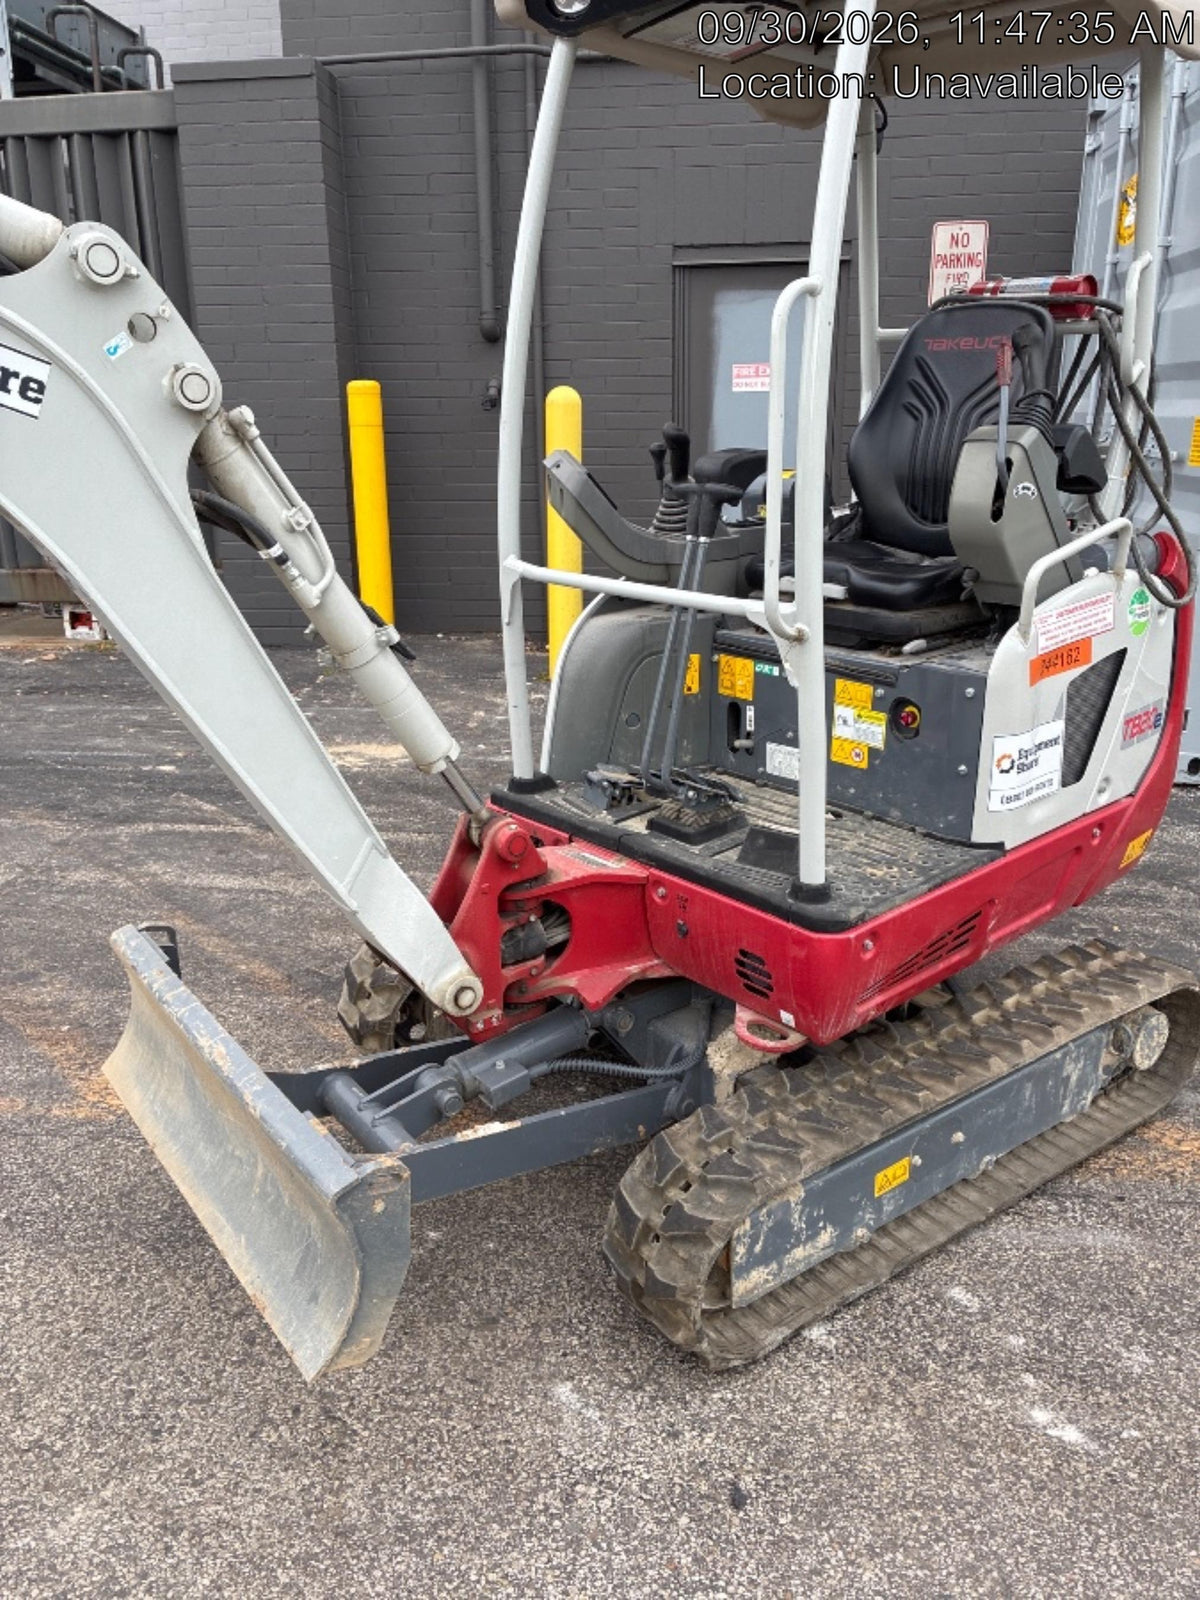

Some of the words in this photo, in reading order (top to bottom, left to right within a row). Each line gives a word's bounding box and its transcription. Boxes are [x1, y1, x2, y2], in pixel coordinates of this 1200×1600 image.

[950, 232, 970, 249] NO
[934, 252, 982, 269] PARKING
[1017, 735, 1061, 761] Equipment
